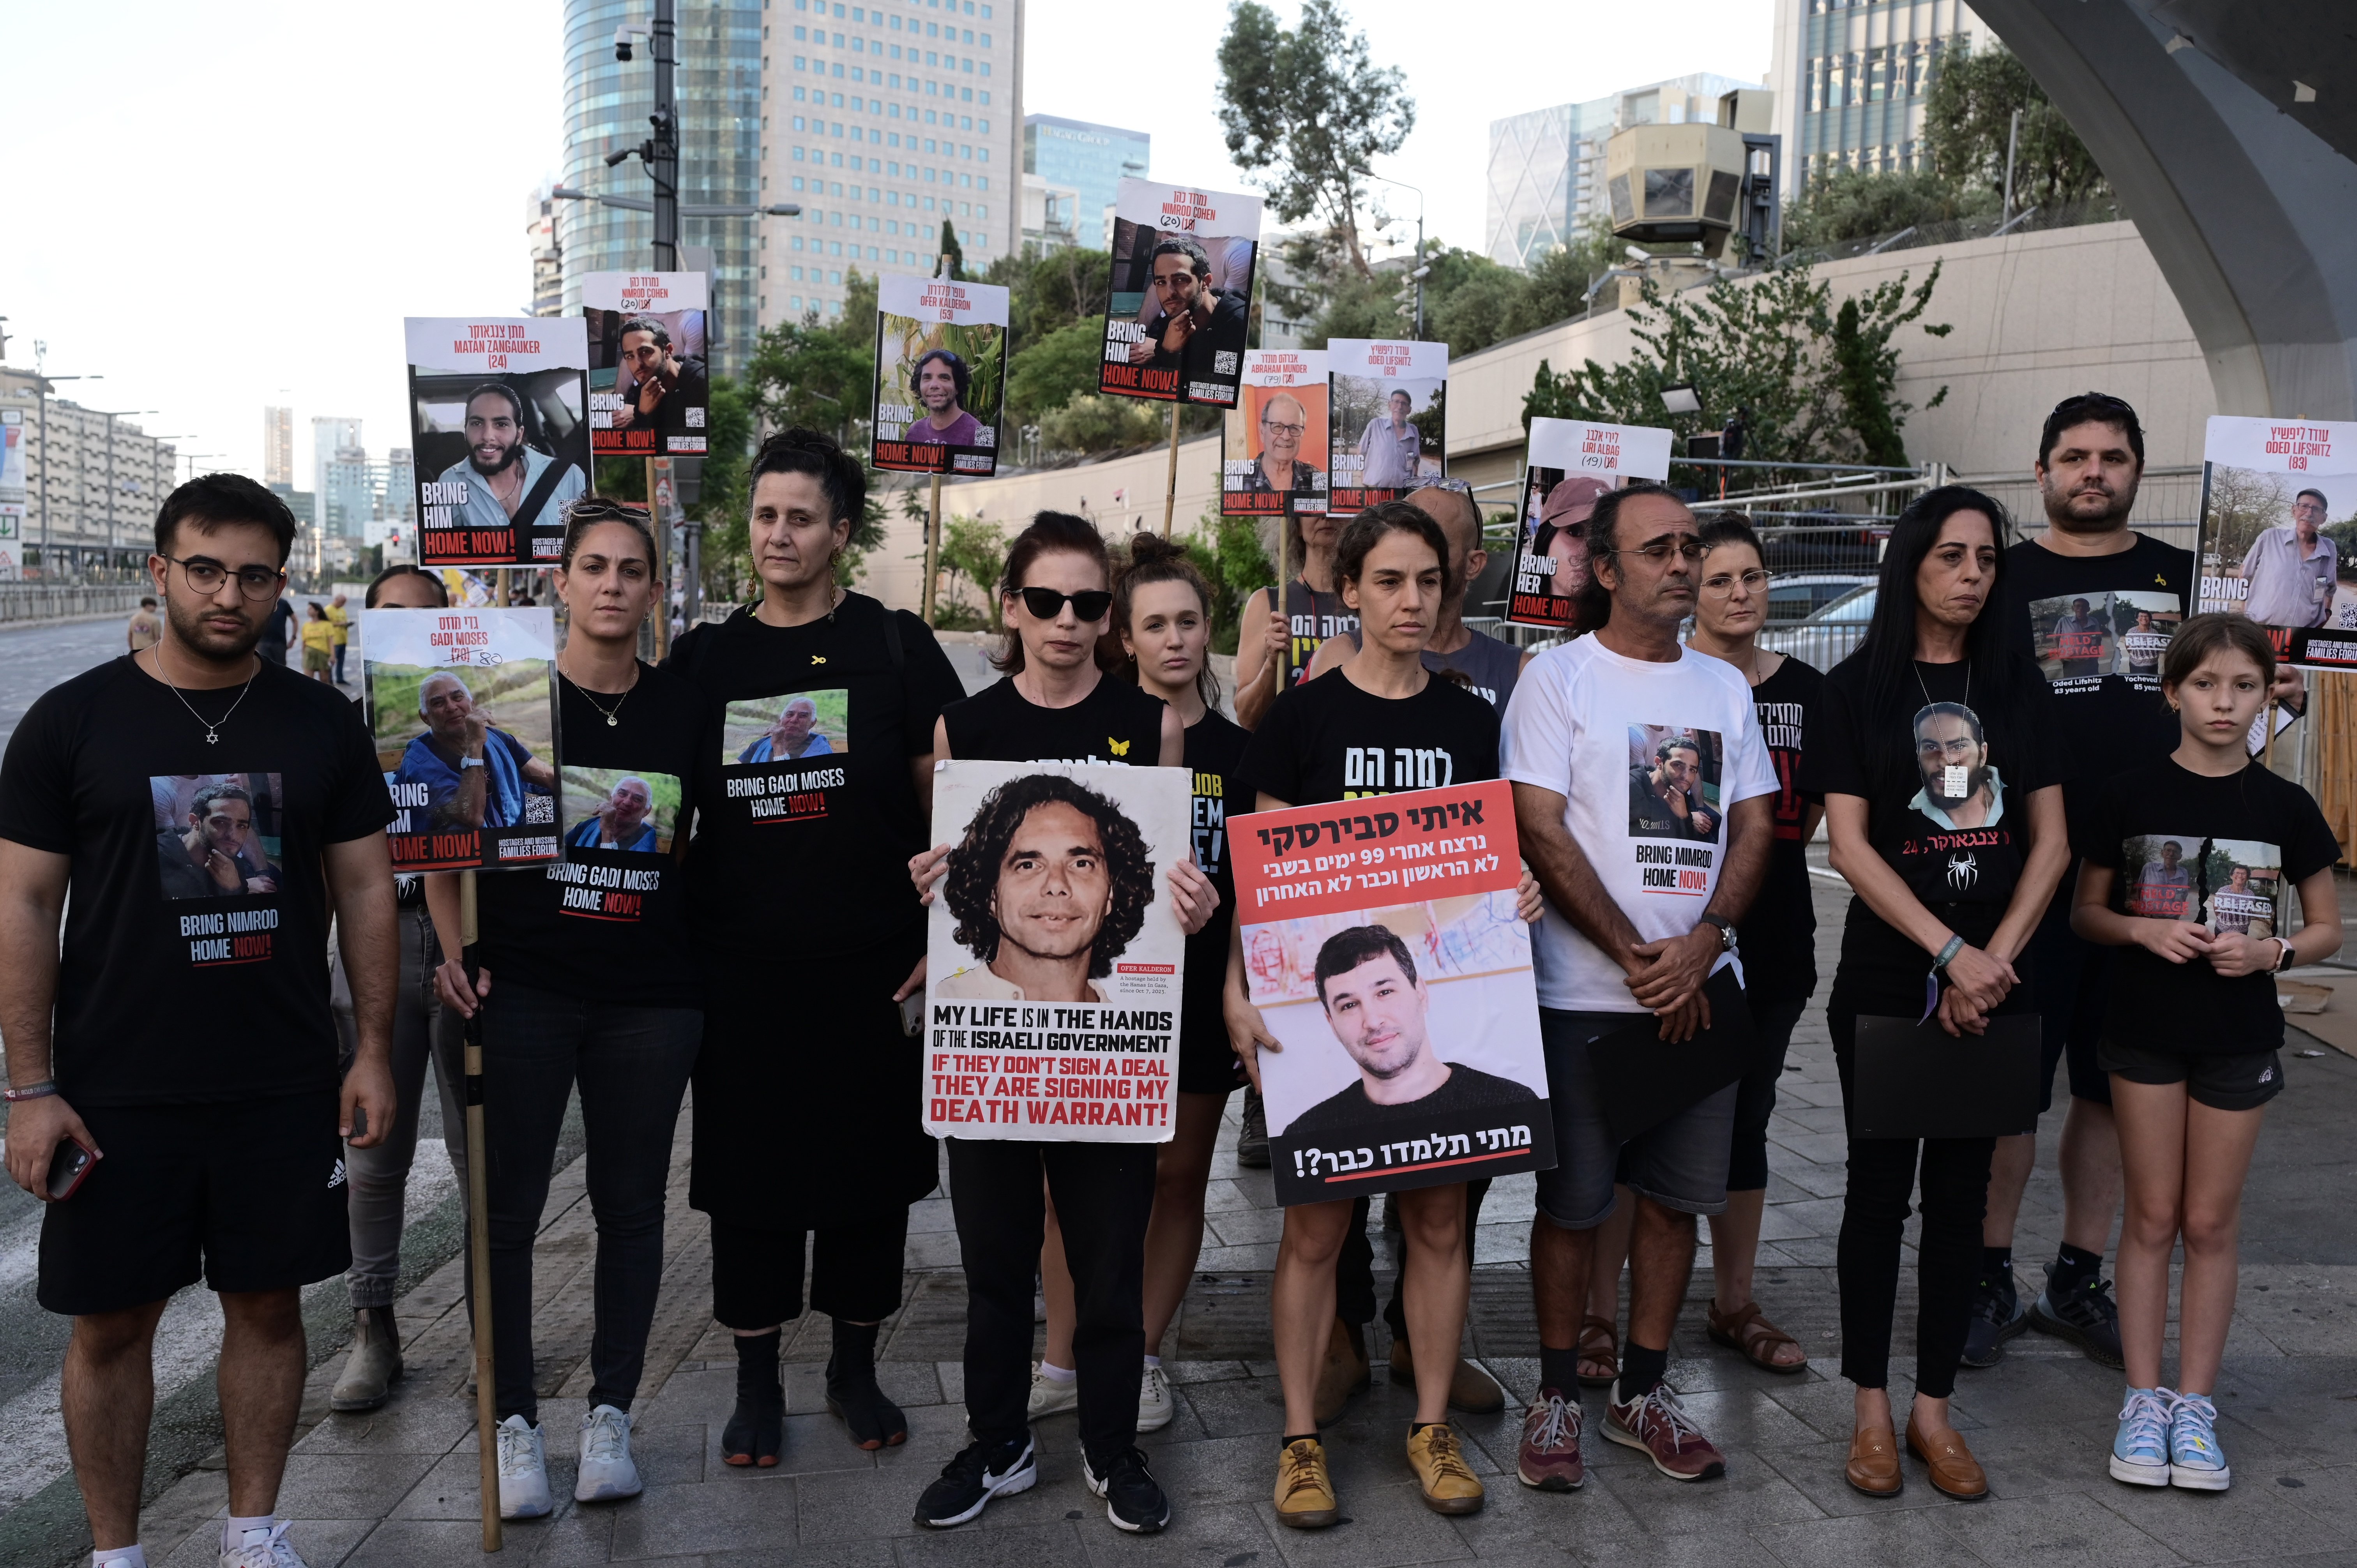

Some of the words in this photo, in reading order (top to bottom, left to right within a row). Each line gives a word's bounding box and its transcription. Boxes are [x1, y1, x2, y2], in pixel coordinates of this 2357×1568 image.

[1174, 191, 1186, 203] כהן
[1189, 192, 1207, 206] נמרוד
[1162, 202, 1191, 217] NIMROD
[1193, 207, 1216, 221] COHEN
[1161, 215, 1180, 228] (20)
[630, 277, 639, 288] כהן
[641, 277, 659, 287] נמרוד
[622, 289, 645, 298] NIMROD
[647, 289, 668, 298] COHEN
[928, 284, 950, 298] קלדרון
[952, 286, 965, 298] עופר
[621, 298, 638, 310] (20)
[921, 295, 937, 307] OFER
[939, 298, 970, 311] KALDERON
[940, 309, 953, 321] (53)
[468, 325, 505, 339] צנגאוקר
[509, 325, 524, 338] מתן
[1108, 320, 1146, 344] BRING
[454, 341, 484, 353] MATAN
[488, 340, 540, 353] ZANGAUKER
[1105, 341, 1130, 363] HIM
[1371, 345, 1391, 356] ליפשיץ
[1392, 345, 1409, 355] עודד
[488, 354, 507, 369] (24)
[1261, 355, 1277, 363] מונדר
[1279, 355, 1298, 363] אברהם
[1369, 356, 1384, 365] ODED
[1385, 357, 1411, 366] LIFSHITZ
[1251, 364, 1281, 373] ABRAHAM
[1283, 364, 1307, 373] MUNDER
[1384, 366, 1396, 376] (83)
[1103, 364, 1138, 387] HOME
[1141, 369, 1178, 392] NOW!
[1264, 375, 1281, 385] (79)
[1190, 381, 1209, 390] HOSTAGES
[1219, 384, 1235, 393] MISSING
[1189, 389, 1214, 400] FAMILIES
[1215, 391, 1233, 402] FORUM
[1586, 429, 1603, 441] אלבג
[1606, 431, 1618, 443] לירי
[2271, 426, 2305, 441] ליפשיץ
[2308, 428, 2329, 441] עודד
[1583, 442, 1595, 454] LIRI
[1598, 444, 1620, 456] ALBAG
[2265, 441, 2290, 454] ODED
[2293, 442, 2330, 457] LIFSHITZ
[1582, 456, 1602, 468] (19)
[2289, 456, 2307, 470] (83)
[422, 482, 468, 505] BRING
[424, 507, 452, 529] HIM
[425, 532, 467, 554] HOME
[472, 528, 516, 553] NOW!
[533, 546, 562, 556] FAMILIES
[1519, 554, 1557, 575] BRING
[1516, 574, 1541, 594] HER
[2200, 576, 2248, 600] BRING
[1513, 595, 1549, 616] HOME
[438, 617, 461, 630] מוזס
[465, 616, 479, 629] גדי
[1292, 615, 1316, 636] הם
[431, 633, 453, 646] GADI
[456, 632, 488, 645] MOSES
[2060, 636, 2091, 645] HELD
[2308, 639, 2332, 648] HOSTAGES
[479, 652, 502, 665] 80
[2048, 646, 2104, 657] HOSTAGE
[2306, 647, 2338, 659] FAMILIES
[1345, 747, 1384, 786] הם
[1395, 747, 1452, 788] למה
[727, 777, 764, 797] BRING
[769, 774, 798, 794] GADI
[801, 768, 844, 790] MOSES
[1192, 773, 1222, 796] JOB
[751, 797, 787, 818] HOME
[788, 792, 825, 813] NOW!
[1406, 799, 1484, 832] איתי
[499, 838, 523, 847] HOSTAGES
[524, 837, 534, 846] AND
[535, 836, 556, 845] MISSING
[1257, 812, 1399, 856] סבירסקי
[433, 830, 481, 858] NOW!
[499, 846, 531, 858] FAMILIES
[532, 844, 557, 855] FORUM
[1389, 841, 1435, 860] אחרי
[1440, 835, 1486, 855] נרצח
[1903, 840, 1918, 855] 24
[1315, 853, 1355, 871] ימים
[1360, 848, 1384, 865] 99
[1474, 854, 1499, 873] לא
[1636, 845, 1672, 864] BRING
[1675, 847, 1712, 868] MIMROD
[1263, 859, 1311, 878] בשבי
[1403, 861, 1469, 888] הראשון
[1327, 874, 1352, 893] לא
[1357, 870, 1398, 888] וכבר
[1643, 868, 1677, 887] HOME
[1679, 870, 1706, 892] NOW!
[1256, 881, 1322, 907] האחרון
[2214, 897, 2272, 913] RELEASED
[180, 913, 224, 936] BRING
[227, 909, 278, 932] NIMROD
[191, 938, 231, 961] HOME
[235, 934, 271, 957] NOW!
[934, 1005, 966, 1025] MY
[970, 1007, 1016, 1027] LIFE
[1022, 1008, 1034, 1027] IS
[1037, 1009, 1049, 1028] IN
[1054, 1010, 1095, 1029] THE
[1100, 1012, 1172, 1031] HANDS
[933, 1029, 946, 1047] OF
[948, 1030, 967, 1048] THE
[971, 1031, 1042, 1050] ISRAELI
[1047, 1033, 1171, 1053] GOVERNMENT
[933, 1054, 949, 1071] IF
[953, 1055, 999, 1072] THEY
[1059, 1058, 1100, 1075] SIGN
[1104, 1059, 1118, 1075] A
[1121, 1059, 1169, 1077] DEAL
[932, 1075, 989, 1095] THEY
[993, 1076, 1039, 1097] ARE
[1044, 1078, 1131, 1099] SIGNING
[1136, 1080, 1169, 1099] MY
[931, 1099, 1018, 1123] DEATH
[1027, 1102, 1167, 1127] WARRANT!
[1476, 1125, 1532, 1150] מתי
[1380, 1133, 1470, 1165] תלמדו
[1294, 1148, 1373, 1178] כבר?!
[328, 1172, 346, 1188] adida
